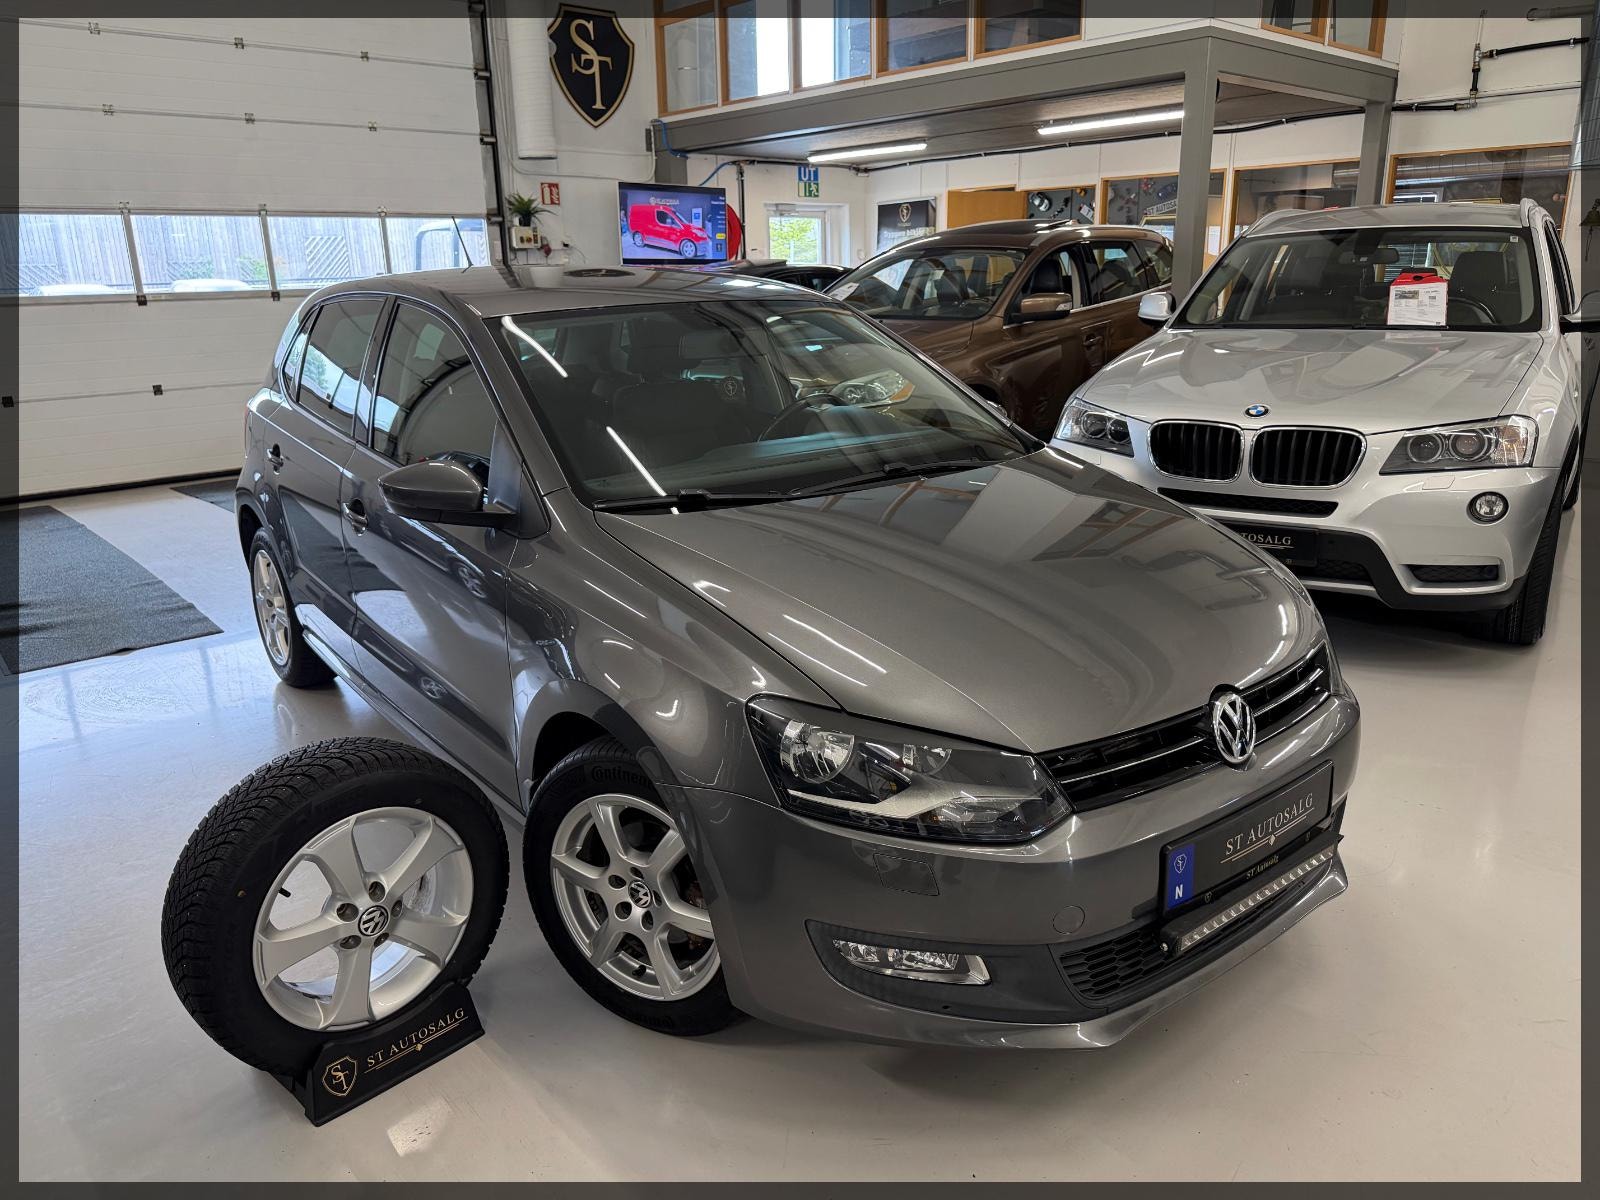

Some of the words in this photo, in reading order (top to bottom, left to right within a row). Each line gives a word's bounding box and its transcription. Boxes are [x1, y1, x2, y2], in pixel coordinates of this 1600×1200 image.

[801, 166, 816, 181] UT
[1226, 833, 1244, 855] ST
[1247, 793, 1313, 844] AUTOSALG
[1175, 884, 1184, 900] N
[367, 1050, 384, 1068] ST
[389, 1007, 465, 1056] AUTOSALG
